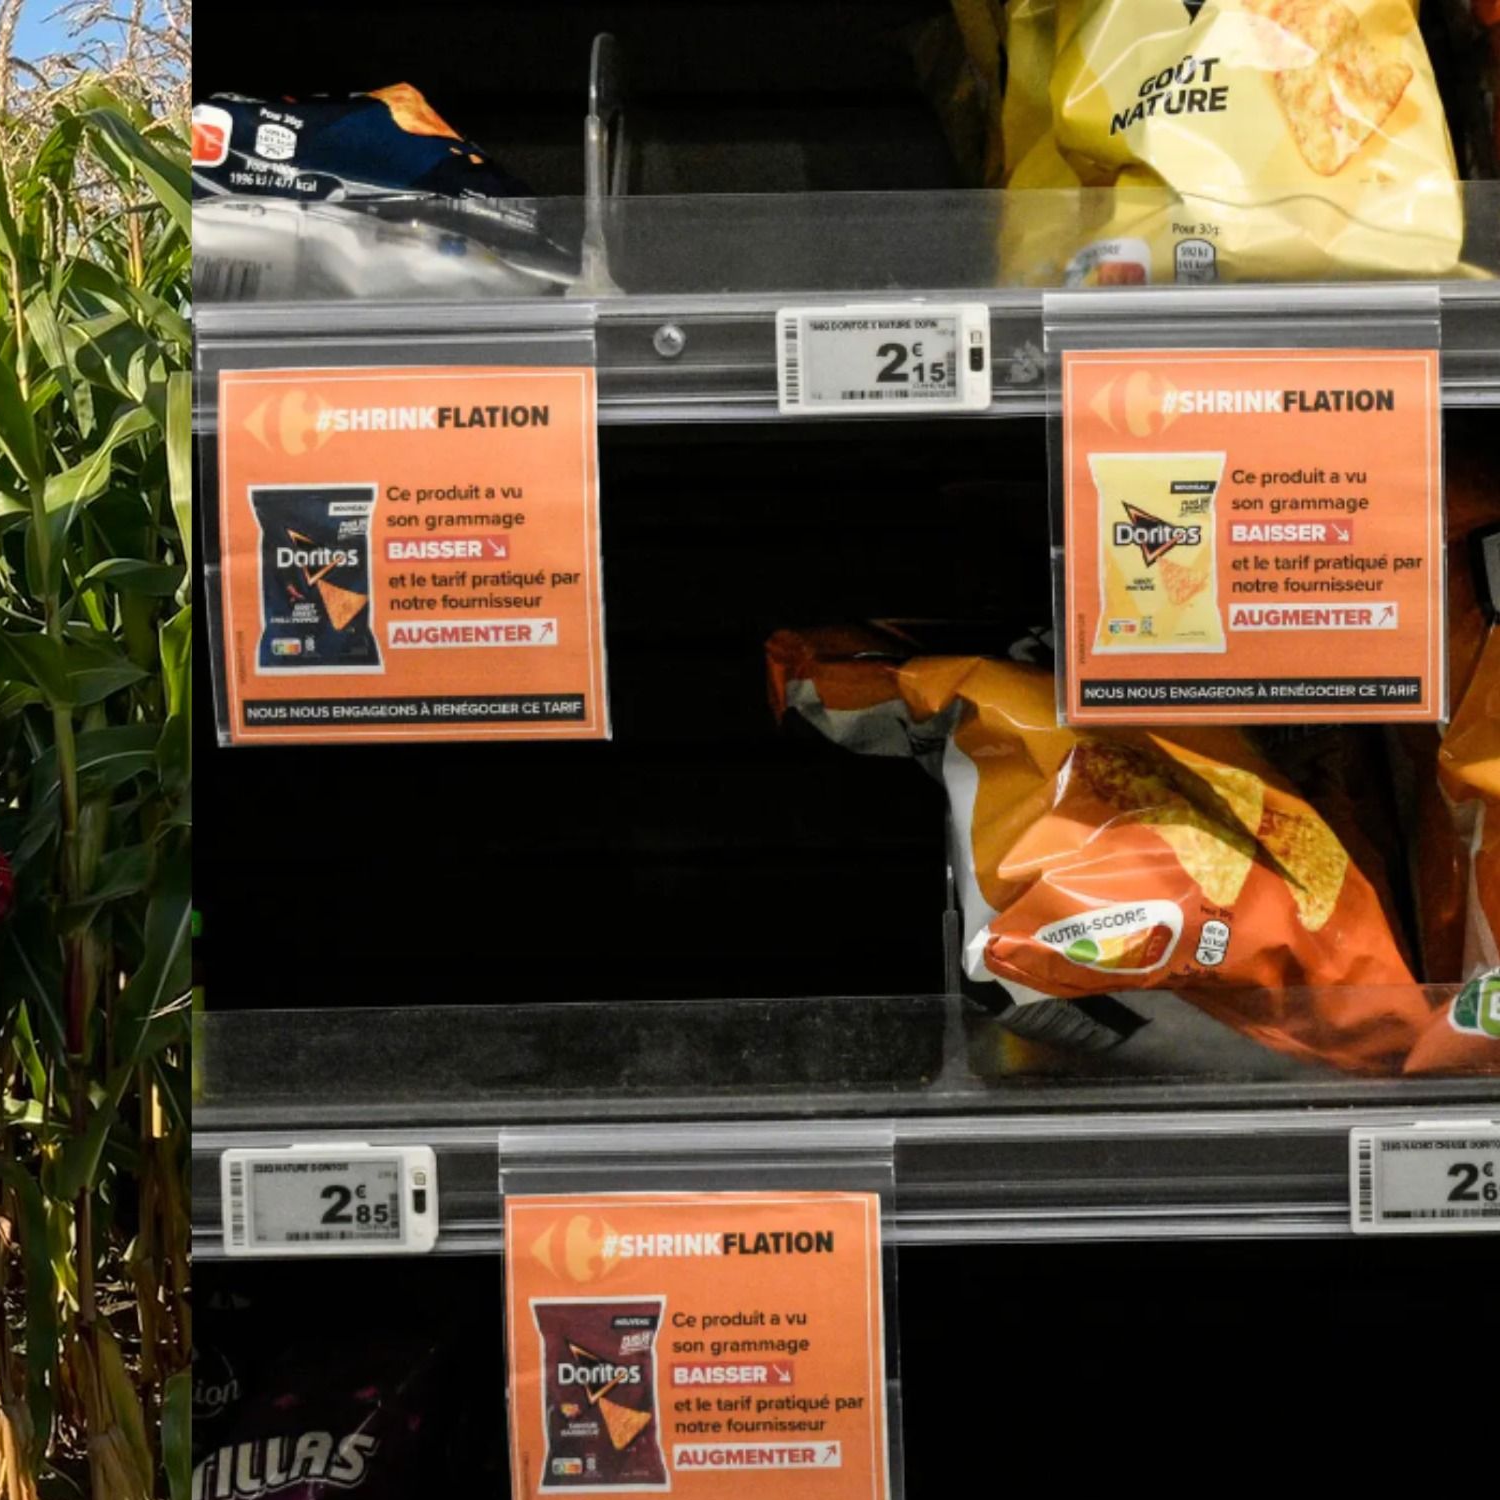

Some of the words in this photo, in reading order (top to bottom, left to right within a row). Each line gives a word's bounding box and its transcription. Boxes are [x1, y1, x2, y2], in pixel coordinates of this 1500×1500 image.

[1139, 55, 1220, 97] GOÛT
[1110, 87, 1228, 135] NATURE
[1161, 390, 1394, 414] #SHRINKFLATION
[315, 404, 550, 431] #SHRINKFLATION
[1232, 469, 1256, 484] Ce
[1260, 469, 1325, 488] produit
[1330, 472, 1339, 483] a
[1345, 472, 1366, 483] vu
[387, 486, 411, 501] Ce
[416, 485, 480, 504] produit
[485, 488, 495, 500] a
[501, 487, 522, 499] vu
[1232, 497, 1263, 510] son
[1270, 496, 1369, 514] grammage
[387, 514, 419, 527] son
[426, 511, 525, 530] grammage
[1115, 524, 1200, 545] Doritos
[1232, 524, 1326, 542] BAISSER
[277, 546, 359, 568] Doritos
[388, 541, 482, 559] BAISSER
[1232, 556, 1249, 570] et
[1254, 555, 1269, 570] le
[1274, 554, 1308, 569] tarif
[1314, 554, 1387, 576] pratiqué
[1394, 556, 1423, 572] par
[389, 574, 406, 588] et
[411, 572, 428, 587] le
[432, 571, 466, 587] tarif
[472, 570, 545, 593] pratiqué
[551, 571, 580, 588] par
[1232, 579, 1278, 593] notre
[1284, 578, 1383, 593] fournisseur
[389, 596, 437, 610] notre
[443, 594, 542, 609] fournisseur
[1232, 608, 1371, 627] AUGMENTER
[392, 625, 531, 644] AUGMENTER
[1084, 687, 1124, 699] NOUS
[1127, 686, 1167, 699] NOUS
[1170, 685, 1255, 699] ENGAGEONS
[1257, 681, 1268, 697] À
[1271, 682, 1356, 697] RENÉGOCIER
[1359, 684, 1377, 697] CE
[1380, 684, 1418, 696] TARIF
[247, 706, 288, 719] NOUS
[289, 706, 330, 718] NOUS
[332, 704, 418, 718] ENGAGEONS
[420, 700, 432, 716] À
[433, 701, 520, 715] RENÉGOCIER
[522, 702, 540, 715] CE
[543, 701, 582, 714] TARIF
[599, 1231, 834, 1258] #SHRINKFLATION
[672, 1313, 696, 1328] Ce
[702, 1311, 765, 1331] produit
[771, 1314, 780, 1326] a
[785, 1313, 807, 1325] vu
[672, 1340, 704, 1354] son
[710, 1338, 810, 1356] grammage
[558, 1362, 641, 1385] Doritos
[674, 1366, 768, 1384] BAISSER
[674, 1397, 692, 1412] et
[696, 1396, 712, 1412] le
[717, 1395, 751, 1411] tarif
[757, 1395, 830, 1417] pratiqué
[835, 1396, 865, 1412] par
[675, 1420, 722, 1434] notre
[727, 1418, 826, 1433] fournisseur
[676, 1448, 816, 1466] AUGMENTER
